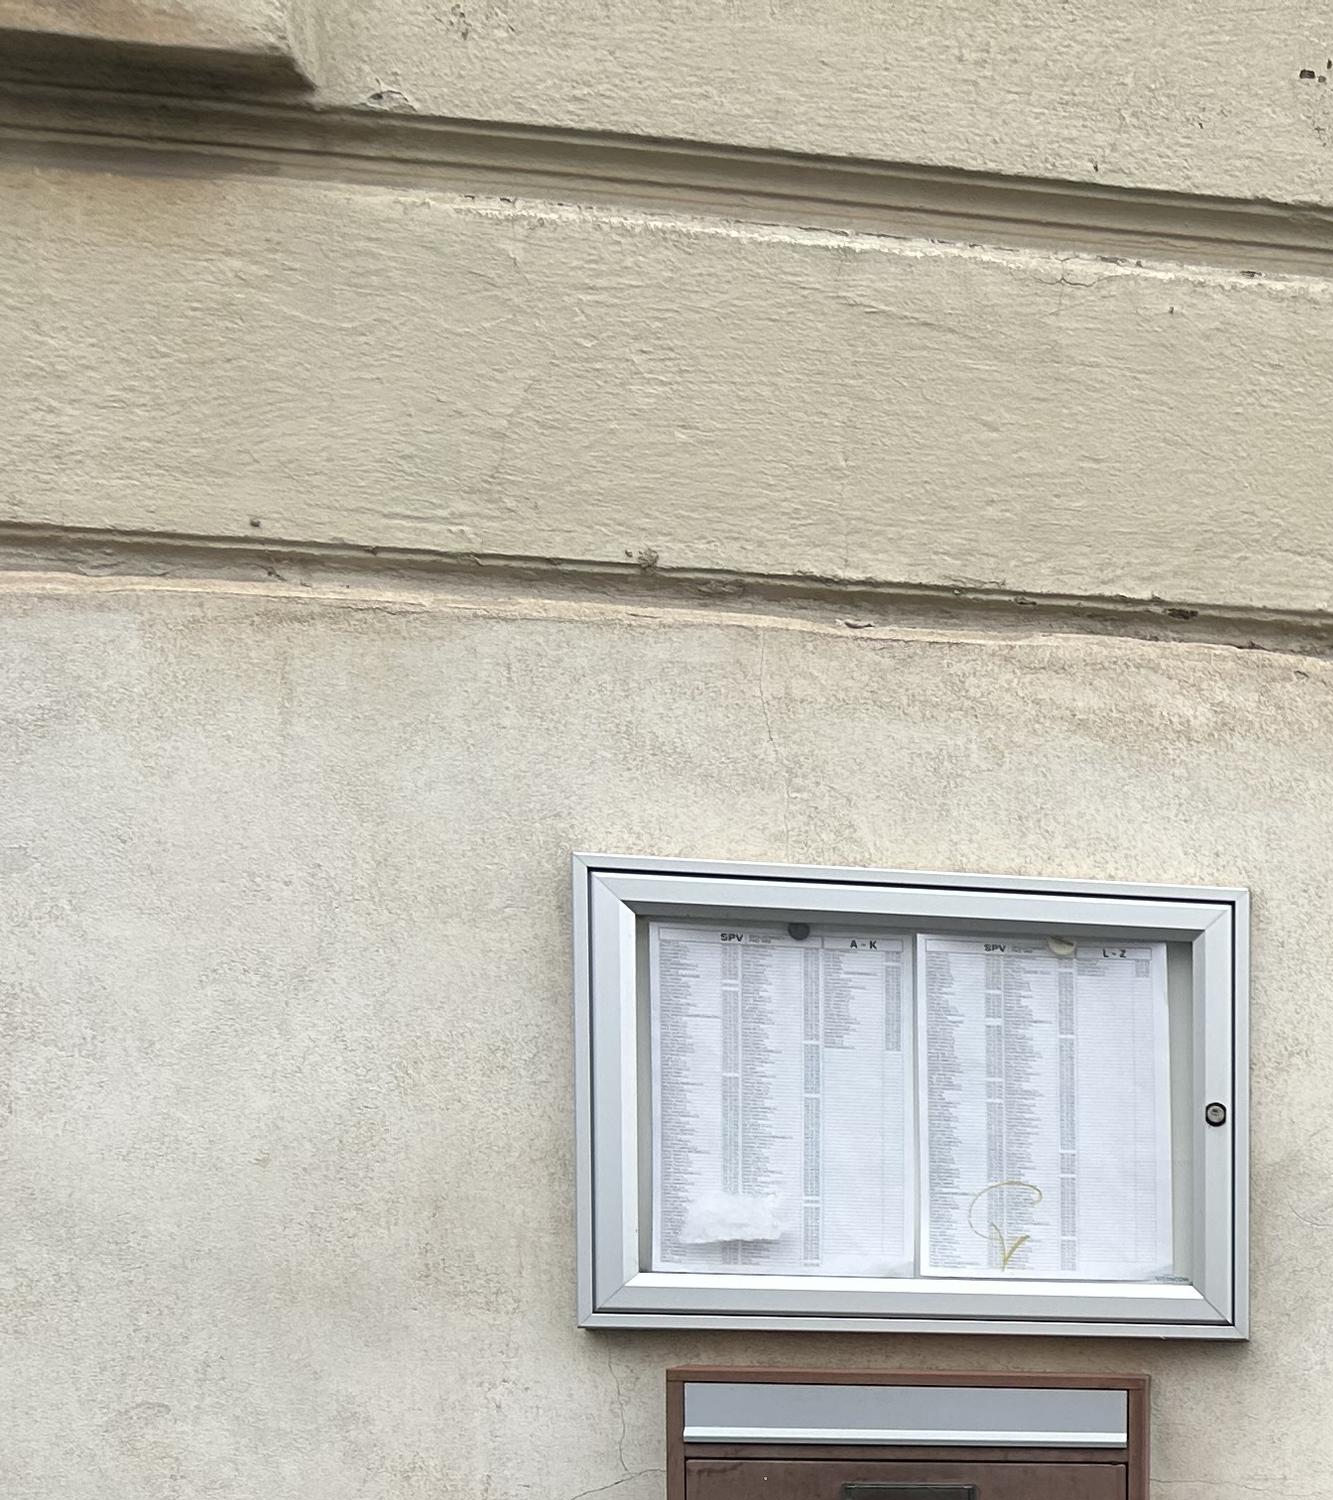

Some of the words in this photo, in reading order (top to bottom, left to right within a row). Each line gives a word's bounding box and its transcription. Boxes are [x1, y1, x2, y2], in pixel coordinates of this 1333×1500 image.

[720, 933, 744, 942] SPV
[850, 940, 858, 949] A
[869, 940, 878, 950] K
[984, 943, 1007, 952] SPV
[1103, 948, 1109, 958] L
[1120, 949, 1127, 958] Z
